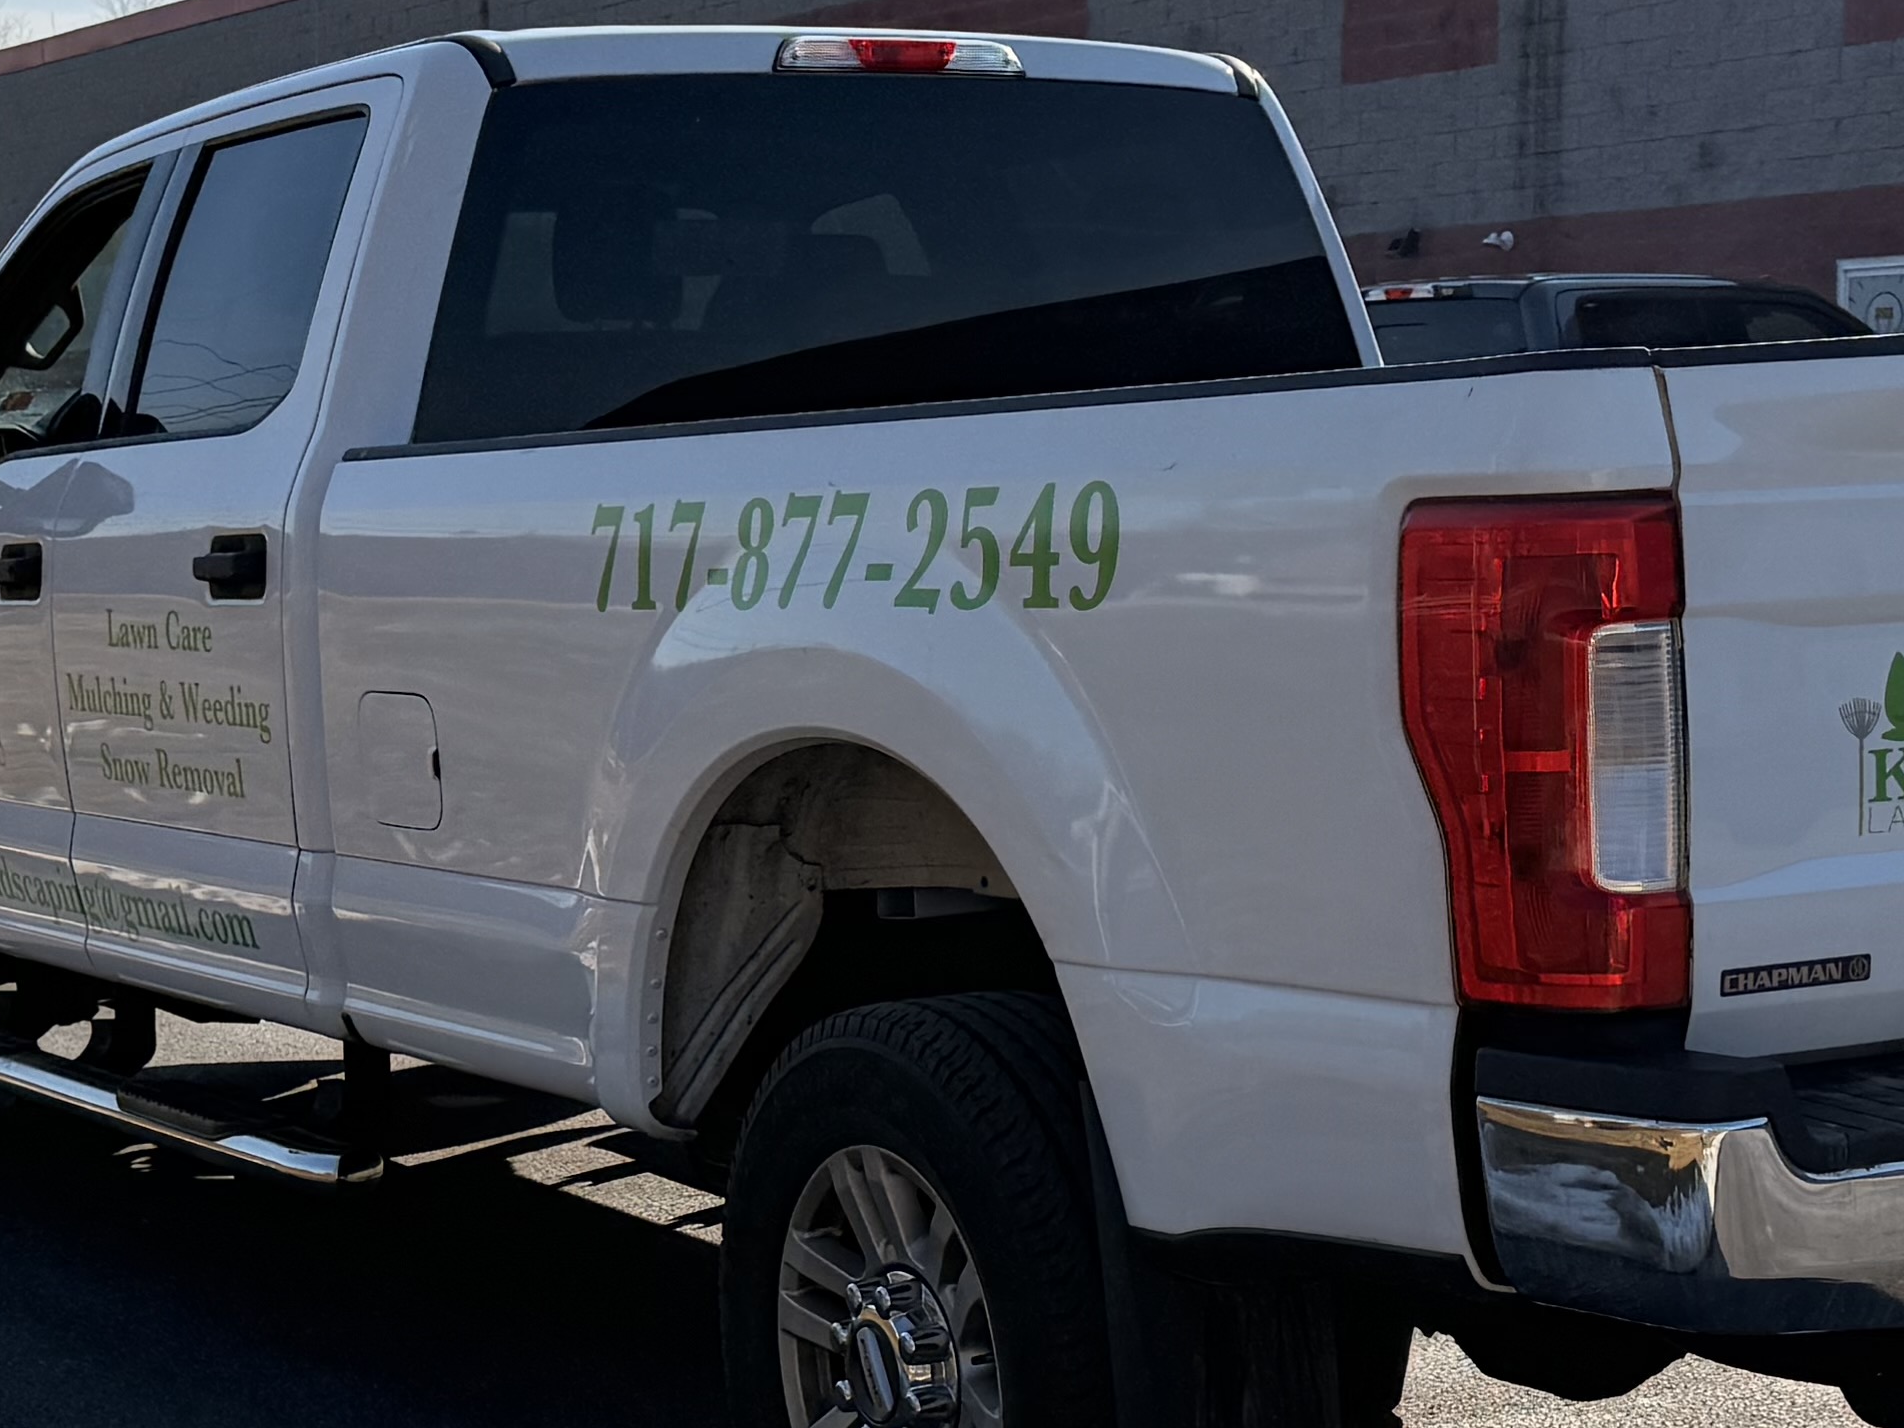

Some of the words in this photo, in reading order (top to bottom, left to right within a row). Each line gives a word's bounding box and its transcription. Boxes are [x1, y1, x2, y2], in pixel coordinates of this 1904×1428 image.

[591, 480, 1120, 615] 717-877-2549
[106, 608, 159, 650] Lawn
[165, 610, 213, 653] Care
[66, 673, 154, 732] Mulching
[159, 680, 175, 721] &
[179, 682, 272, 745] Weeding
[100, 742, 150, 785] Snow
[155, 748, 245, 799] Removal
[1724, 961, 1843, 993] CHAPMAN
